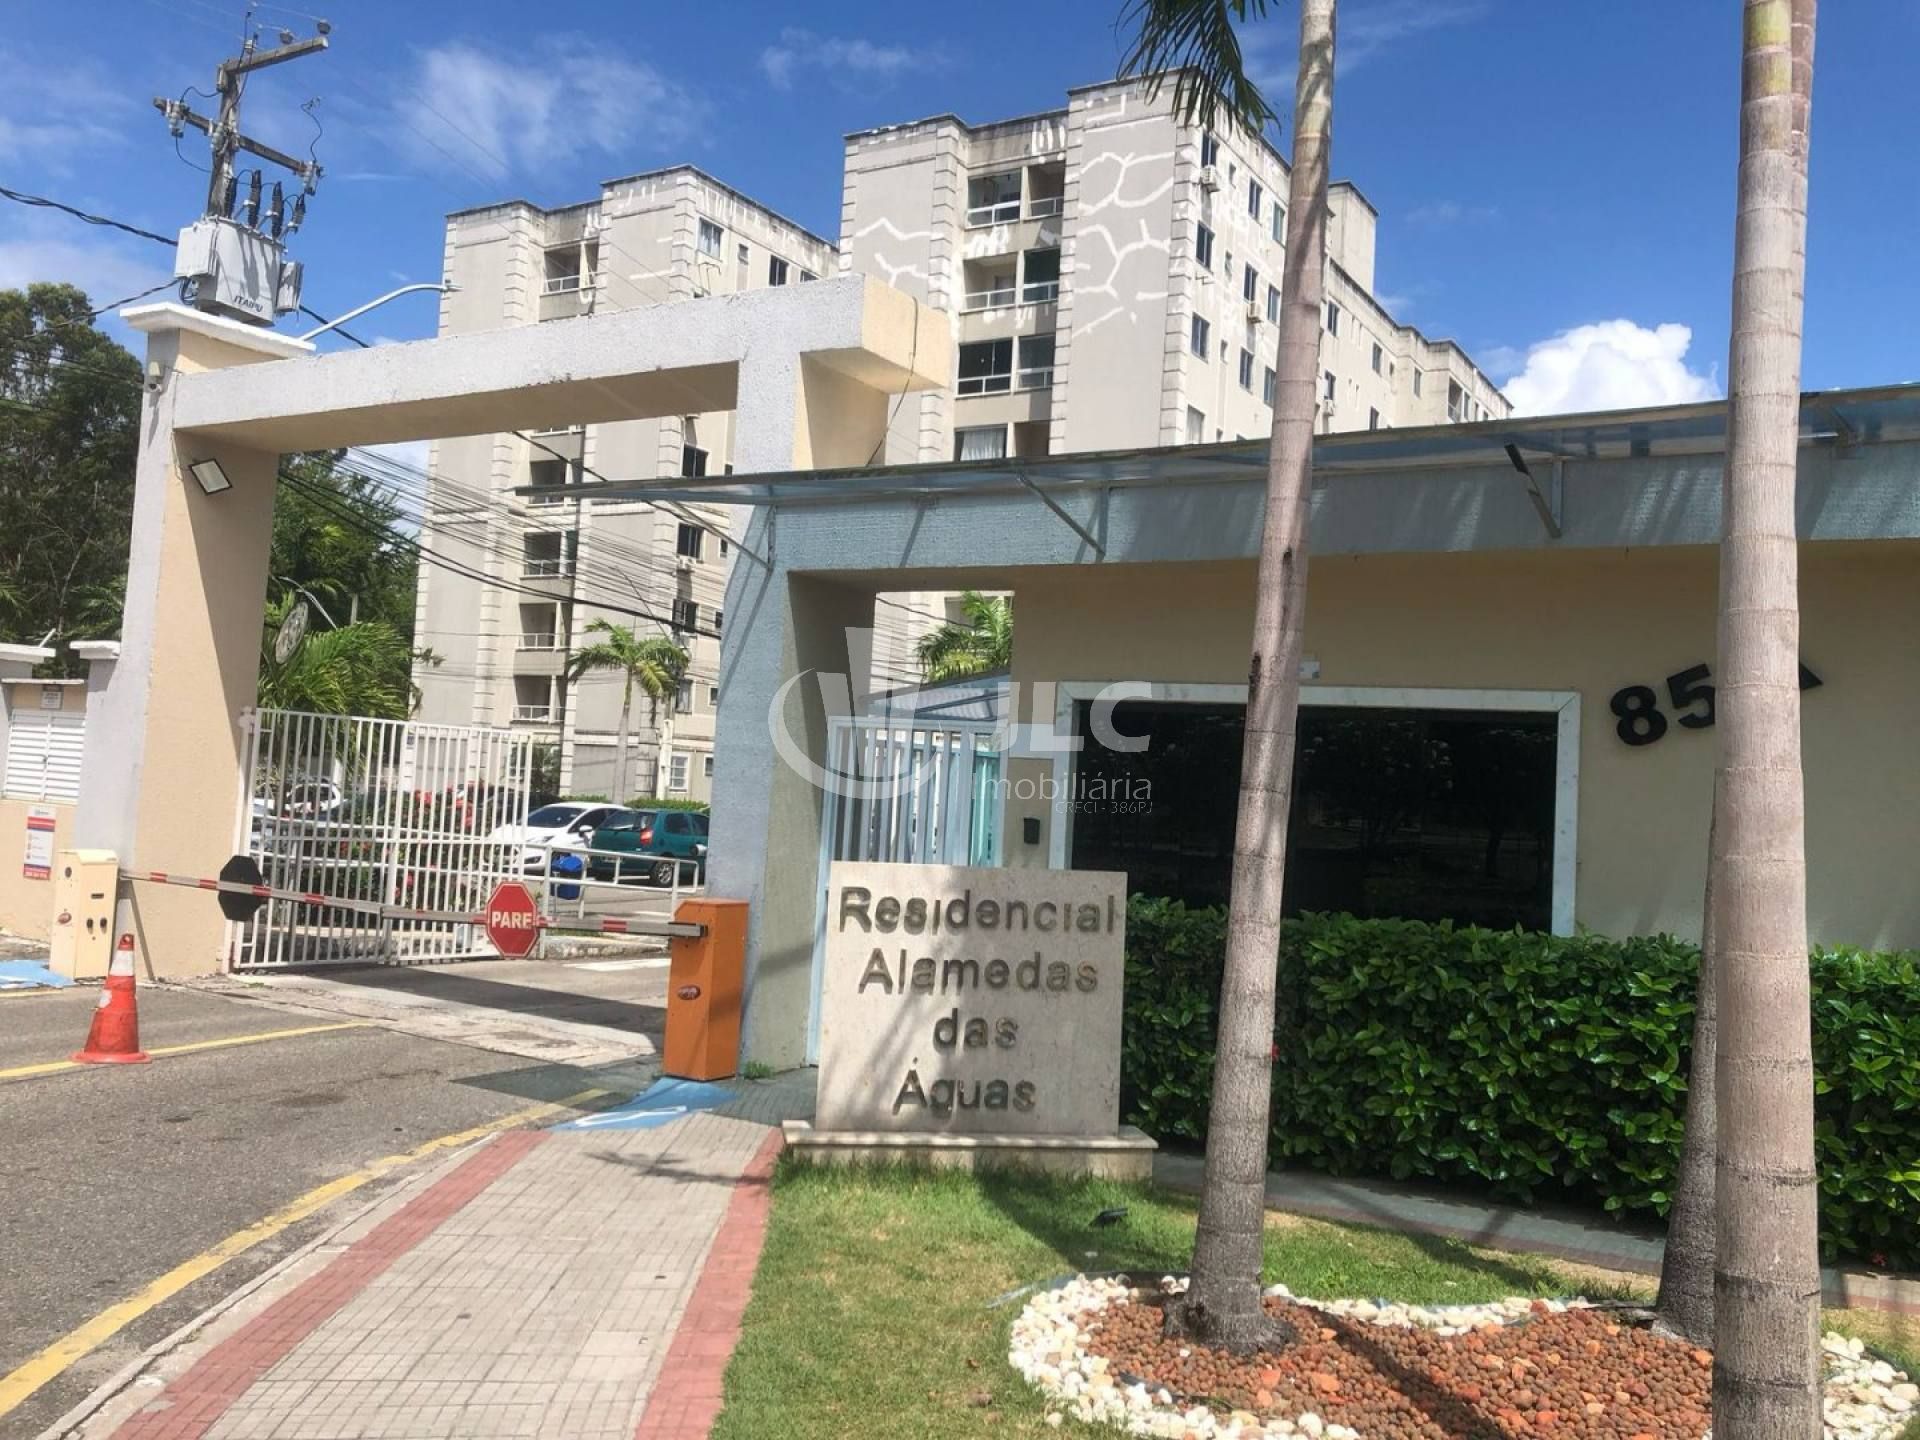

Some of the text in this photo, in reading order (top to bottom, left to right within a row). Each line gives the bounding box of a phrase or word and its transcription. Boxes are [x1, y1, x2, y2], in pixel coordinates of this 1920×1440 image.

[491, 911, 533, 929] PARE
[839, 886, 1115, 936] Residencial
[857, 948, 1099, 996] Alamedas
[932, 1007, 1019, 1055] das
[892, 1056, 1037, 1118] Águas
